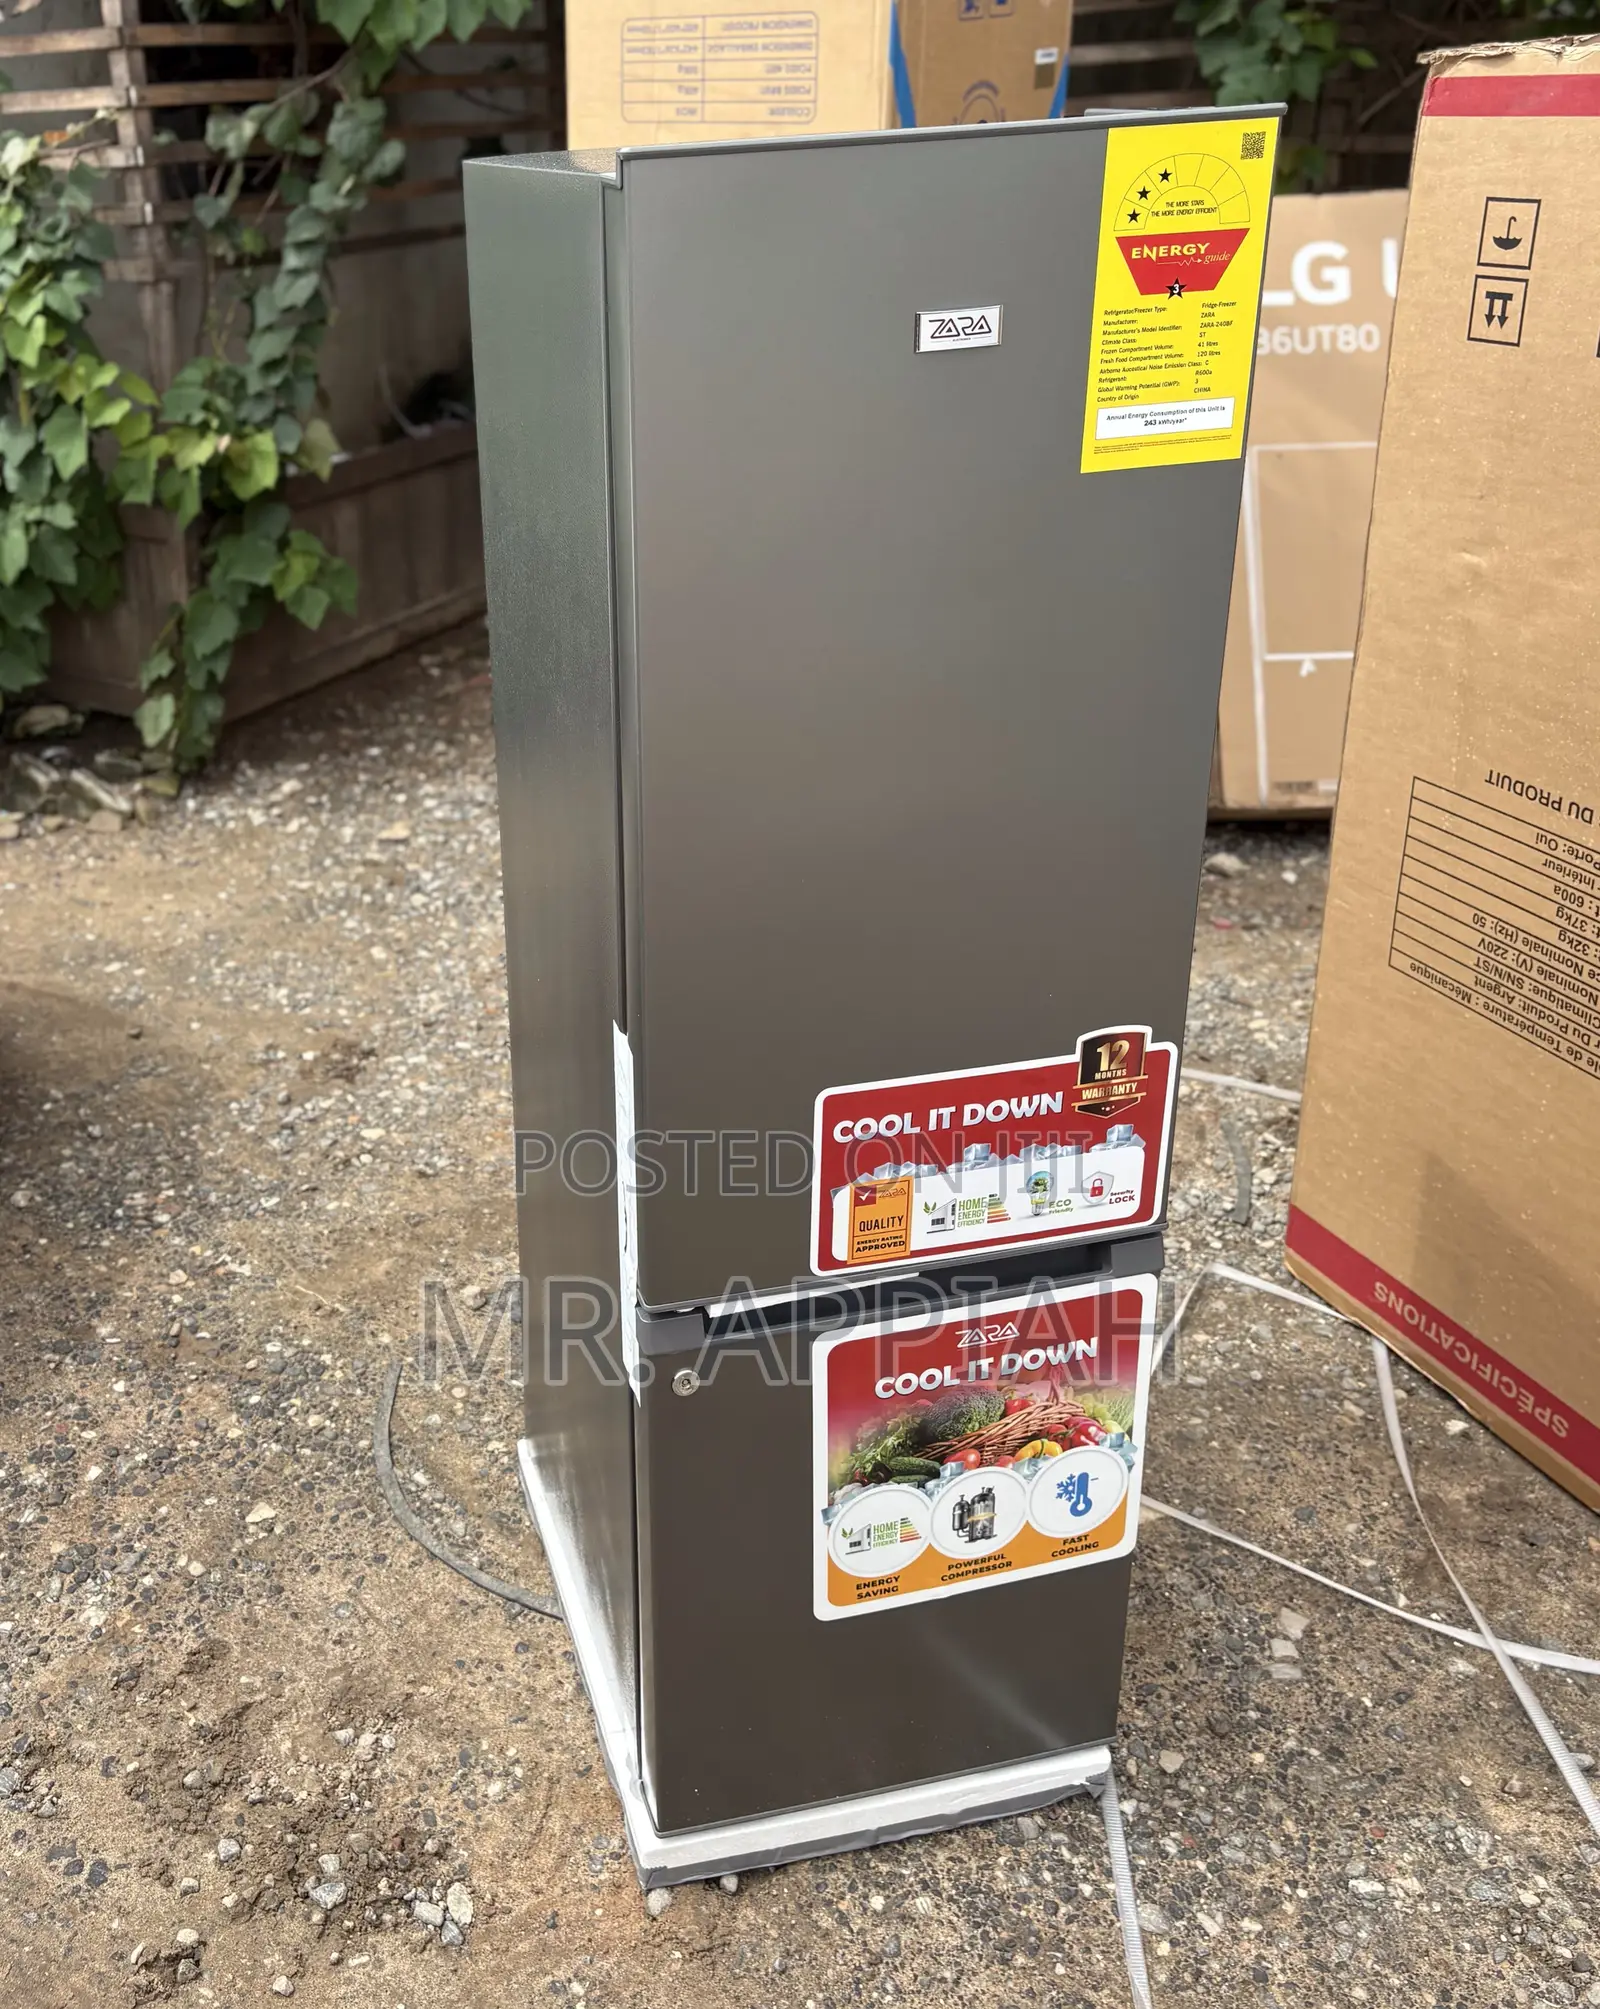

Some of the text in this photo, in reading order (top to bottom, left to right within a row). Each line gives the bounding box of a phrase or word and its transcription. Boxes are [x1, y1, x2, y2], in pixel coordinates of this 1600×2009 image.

[1176, 208, 1194, 216] ENERGY
[1131, 242, 1210, 262] ENERGY
[1203, 251, 1230, 264] guide
[1173, 284, 1180, 293] 3
[928, 314, 992, 339] ZARA
[1097, 395, 1117, 403] Country
[1128, 412, 1148, 420] Energy
[1149, 409, 1188, 418] Consumption
[1484, 769, 1594, 825] DU PRODUIT
[1535, 832, 1558, 851] Oui
[1542, 858, 1595, 890] Intérieur
[1553, 884, 1584, 908] 600a
[1472, 913, 1487, 928] 50
[1556, 906, 1588, 932] 37kg
[1490, 920, 1519, 945] (Hz):
[1477, 937, 1509, 960] 220V
[1557, 929, 1590, 956] 32kg
[1522, 936, 1584, 977] Nominale
[1474, 956, 1525, 990] SN/N/ST
[1409, 962, 1472, 1004] Mécanique
[1536, 965, 1598, 1006] Nominale
[1474, 975, 1591, 1047] Du Produit: Argent
[1483, 1001, 1562, 1053] Température
[1096, 1039, 1130, 1072] 12
[1566, 1046, 1583, 1061] de
[1094, 1068, 1127, 1080] MONTHS
[1081, 1082, 1138, 1100] WARRANTY
[832, 1091, 1064, 1144] COOL IT DOWN
[958, 1196, 988, 1211] HOME
[1048, 1199, 1072, 1209] ECO
[1108, 1194, 1135, 1205] LOCK
[859, 1215, 904, 1232] QUALITY
[957, 1209, 986, 1221] ENERGY
[957, 1218, 985, 1227] EFFICIENCY
[855, 1240, 905, 1253] APPROVED
[856, 1234, 903, 1245] ENERGY RATING
[955, 1321, 1021, 1348] ZARA
[874, 1336, 1099, 1399] COOL IT DOWN
[1373, 1281, 1570, 1438] SPÉCIFICATIONS
[873, 1520, 899, 1532] HOME
[873, 1531, 898, 1541] ENERGY
[1062, 1534, 1090, 1546] FAST
[1051, 1541, 1099, 1557] COOLING
[940, 1560, 1013, 1582] COMPRESSOR
[947, 1553, 1007, 1571] POWERFUL
[856, 1575, 901, 1590] ENERGY
[856, 1585, 899, 1600] SAVING
